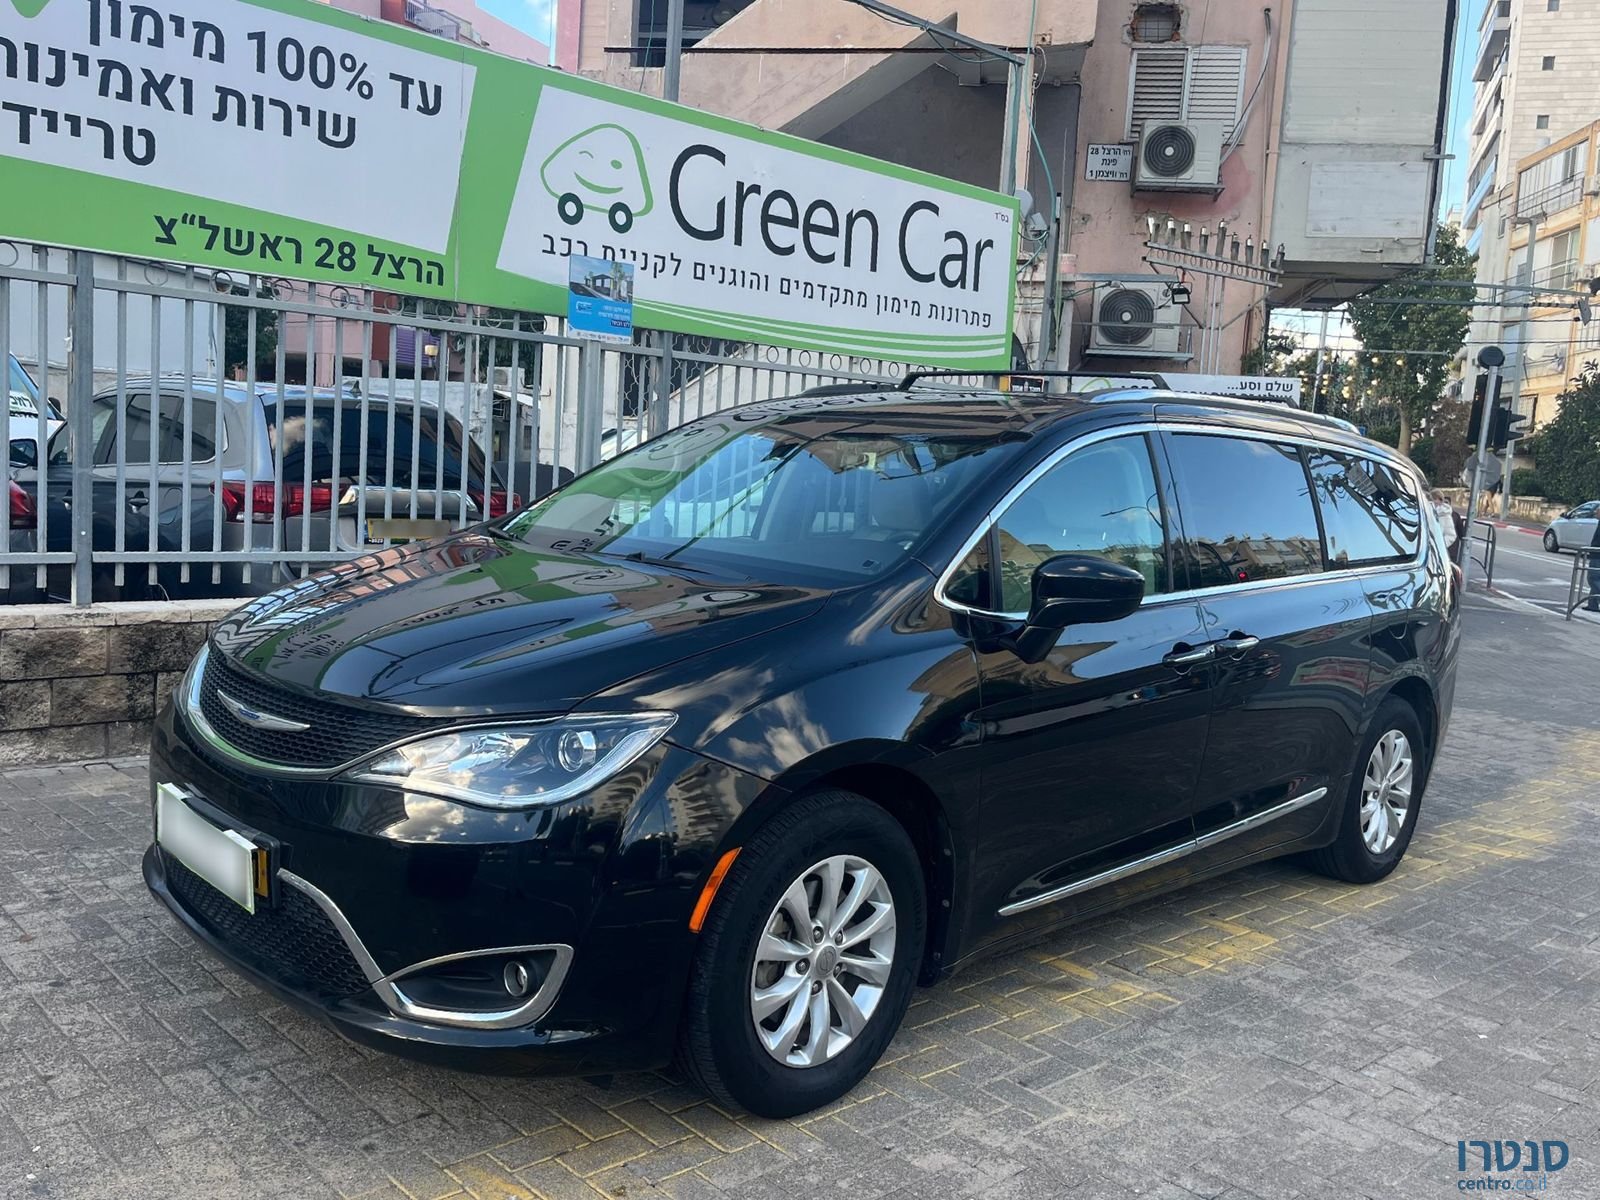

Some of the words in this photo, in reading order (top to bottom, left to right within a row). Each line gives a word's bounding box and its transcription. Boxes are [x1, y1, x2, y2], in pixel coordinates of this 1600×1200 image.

[87, 0, 226, 64] מימון
[247, 30, 375, 101] 100%
[389, 71, 443, 117] עד
[212, 84, 357, 150] שירות
[1, 100, 157, 166] טרייד
[1090, 147, 1100, 155] 28
[1100, 158, 1118, 166] פינת
[1101, 145, 1121, 156] הרצל
[1089, 169, 1094, 177] 1
[669, 144, 880, 273] Green
[899, 199, 994, 293] Car
[314, 237, 357, 273] 28
[541, 233, 588, 258] רכב
[601, 243, 682, 279] לקניית
[367, 243, 445, 287] הרצל
[693, 261, 769, 292] והוגנים
[779, 277, 868, 308] מתקדמים
[875, 294, 921, 317] מימון
[928, 302, 992, 328] פתרונות
[1265, 380, 1293, 392] שלם
